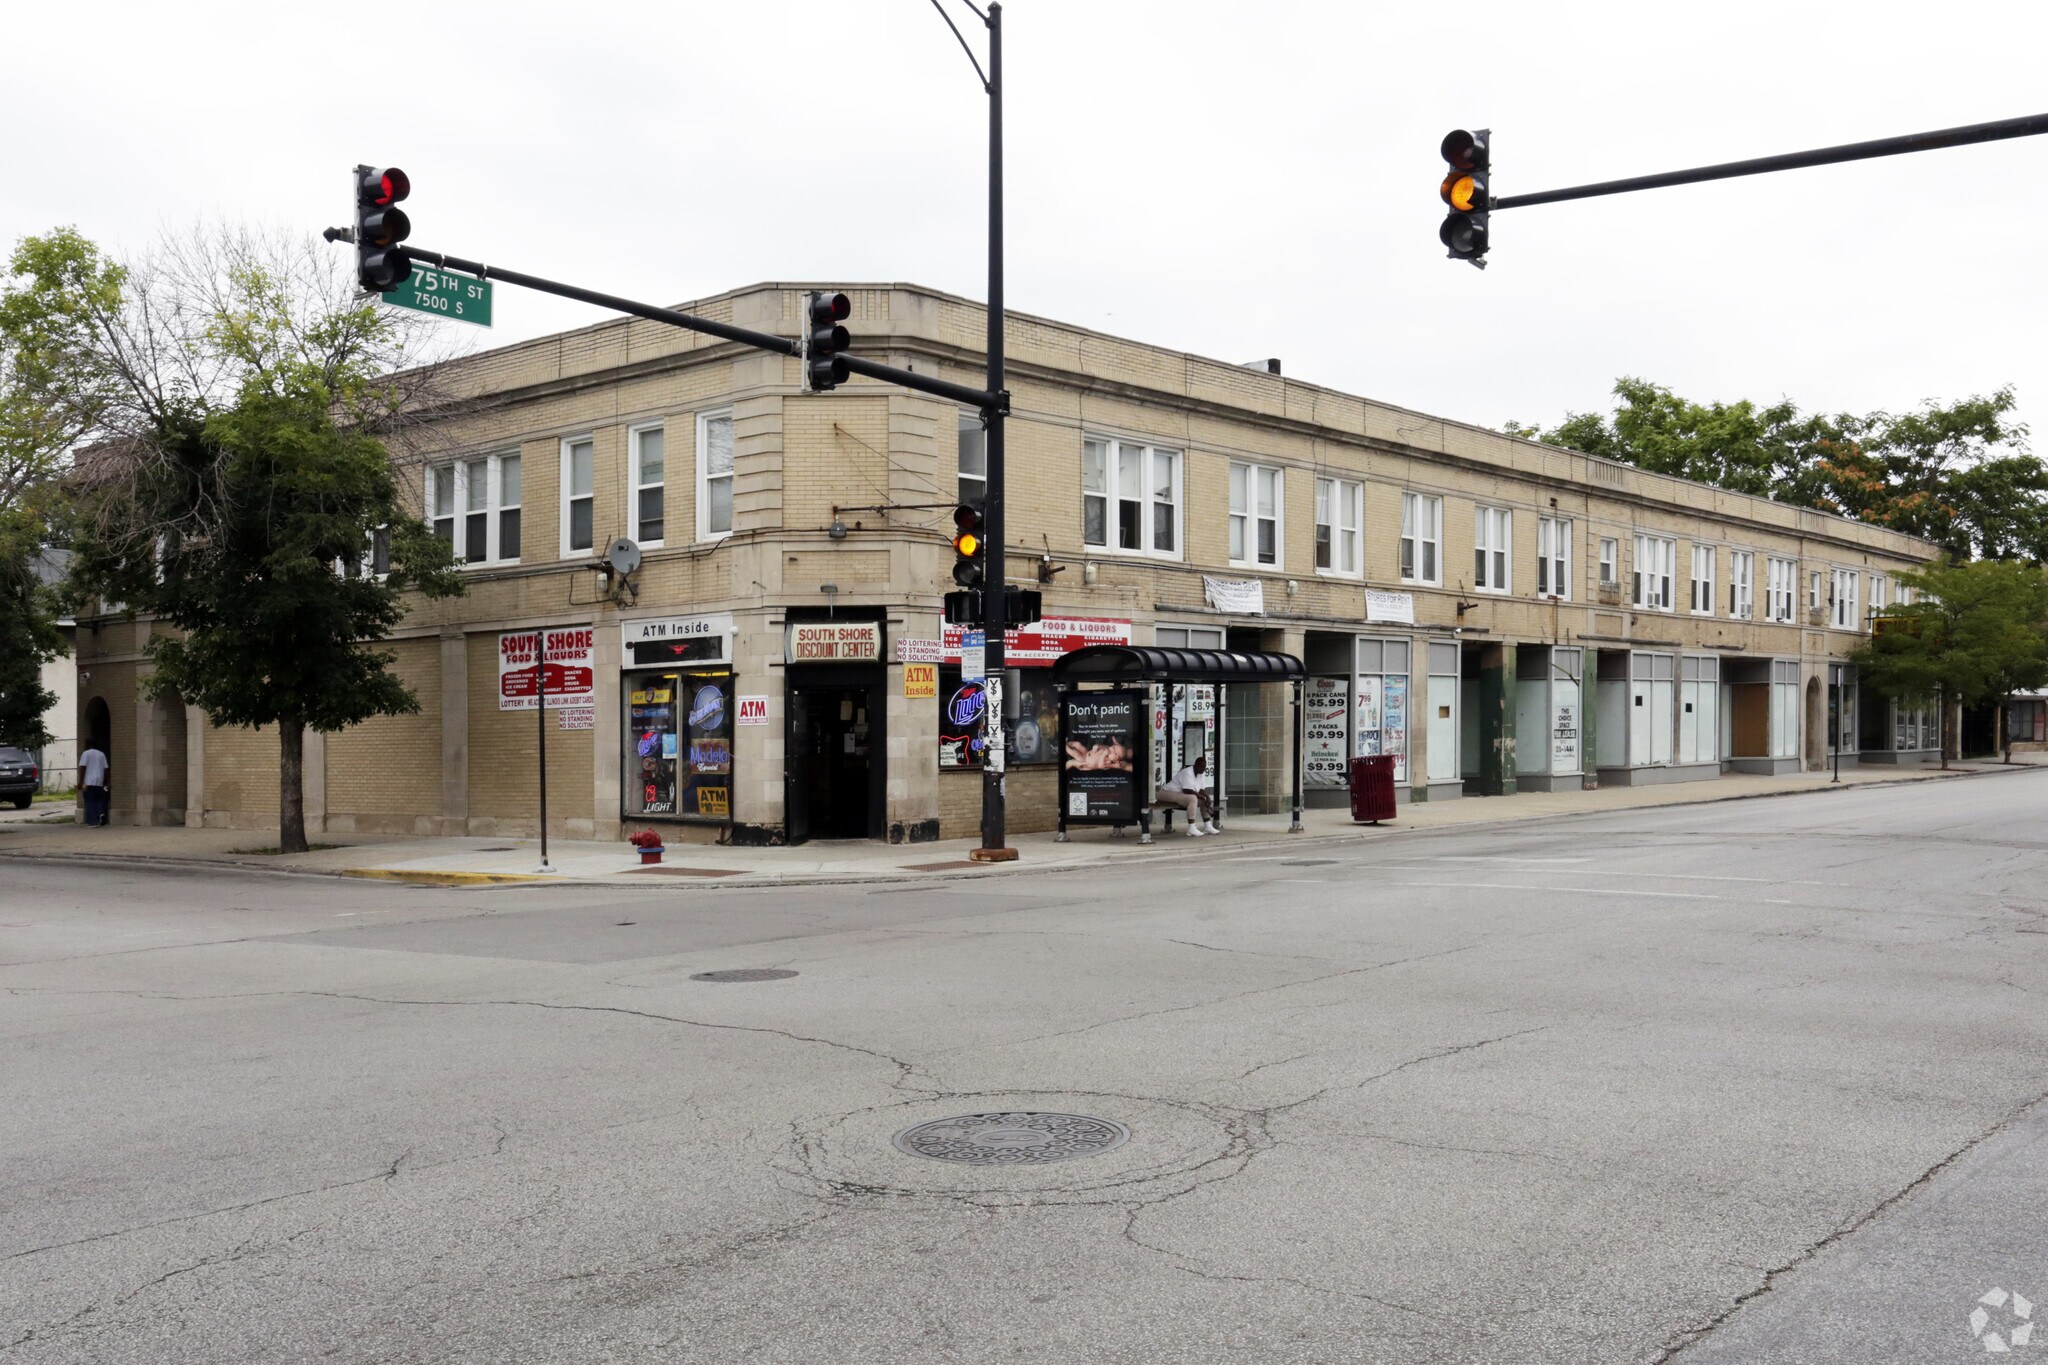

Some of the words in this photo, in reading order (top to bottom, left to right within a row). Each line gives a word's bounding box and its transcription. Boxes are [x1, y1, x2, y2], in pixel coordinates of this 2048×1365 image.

[411, 268, 458, 291] 75TH
[467, 285, 484, 300] ST
[414, 291, 448, 311] 7500
[456, 302, 463, 314] S
[642, 624, 666, 637] ATM
[672, 621, 709, 635] Inside
[798, 629, 835, 641] SOUTH
[838, 627, 874, 641] SHORE
[1042, 622, 1066, 631] FOOD
[1070, 623, 1076, 631] &
[1079, 623, 1117, 633] LIQUORS
[547, 630, 593, 651] SHORE
[908, 640, 942, 648] LOITERING
[796, 642, 839, 658] DISCOUNT
[842, 641, 875, 658] CENTER
[908, 647, 941, 655] STANDING
[506, 653, 531, 664] FOOD
[544, 649, 588, 661] LIQUORS
[908, 654, 944, 662] SOLICITING
[905, 667, 934, 682] ATM
[905, 685, 934, 696] Inside
[501, 699, 524, 708] LOTTERY
[739, 700, 766, 718] ATM
[1308, 698, 1345, 708] $5.99
[1069, 703, 1098, 716] Don't
[1101, 702, 1130, 719] panic
[1307, 730, 1345, 740] $9.99
[690, 746, 728, 763] Modelo
[1307, 762, 1345, 772] $9.99
[701, 790, 726, 802] ATM
[646, 802, 672, 812] LIGHT
